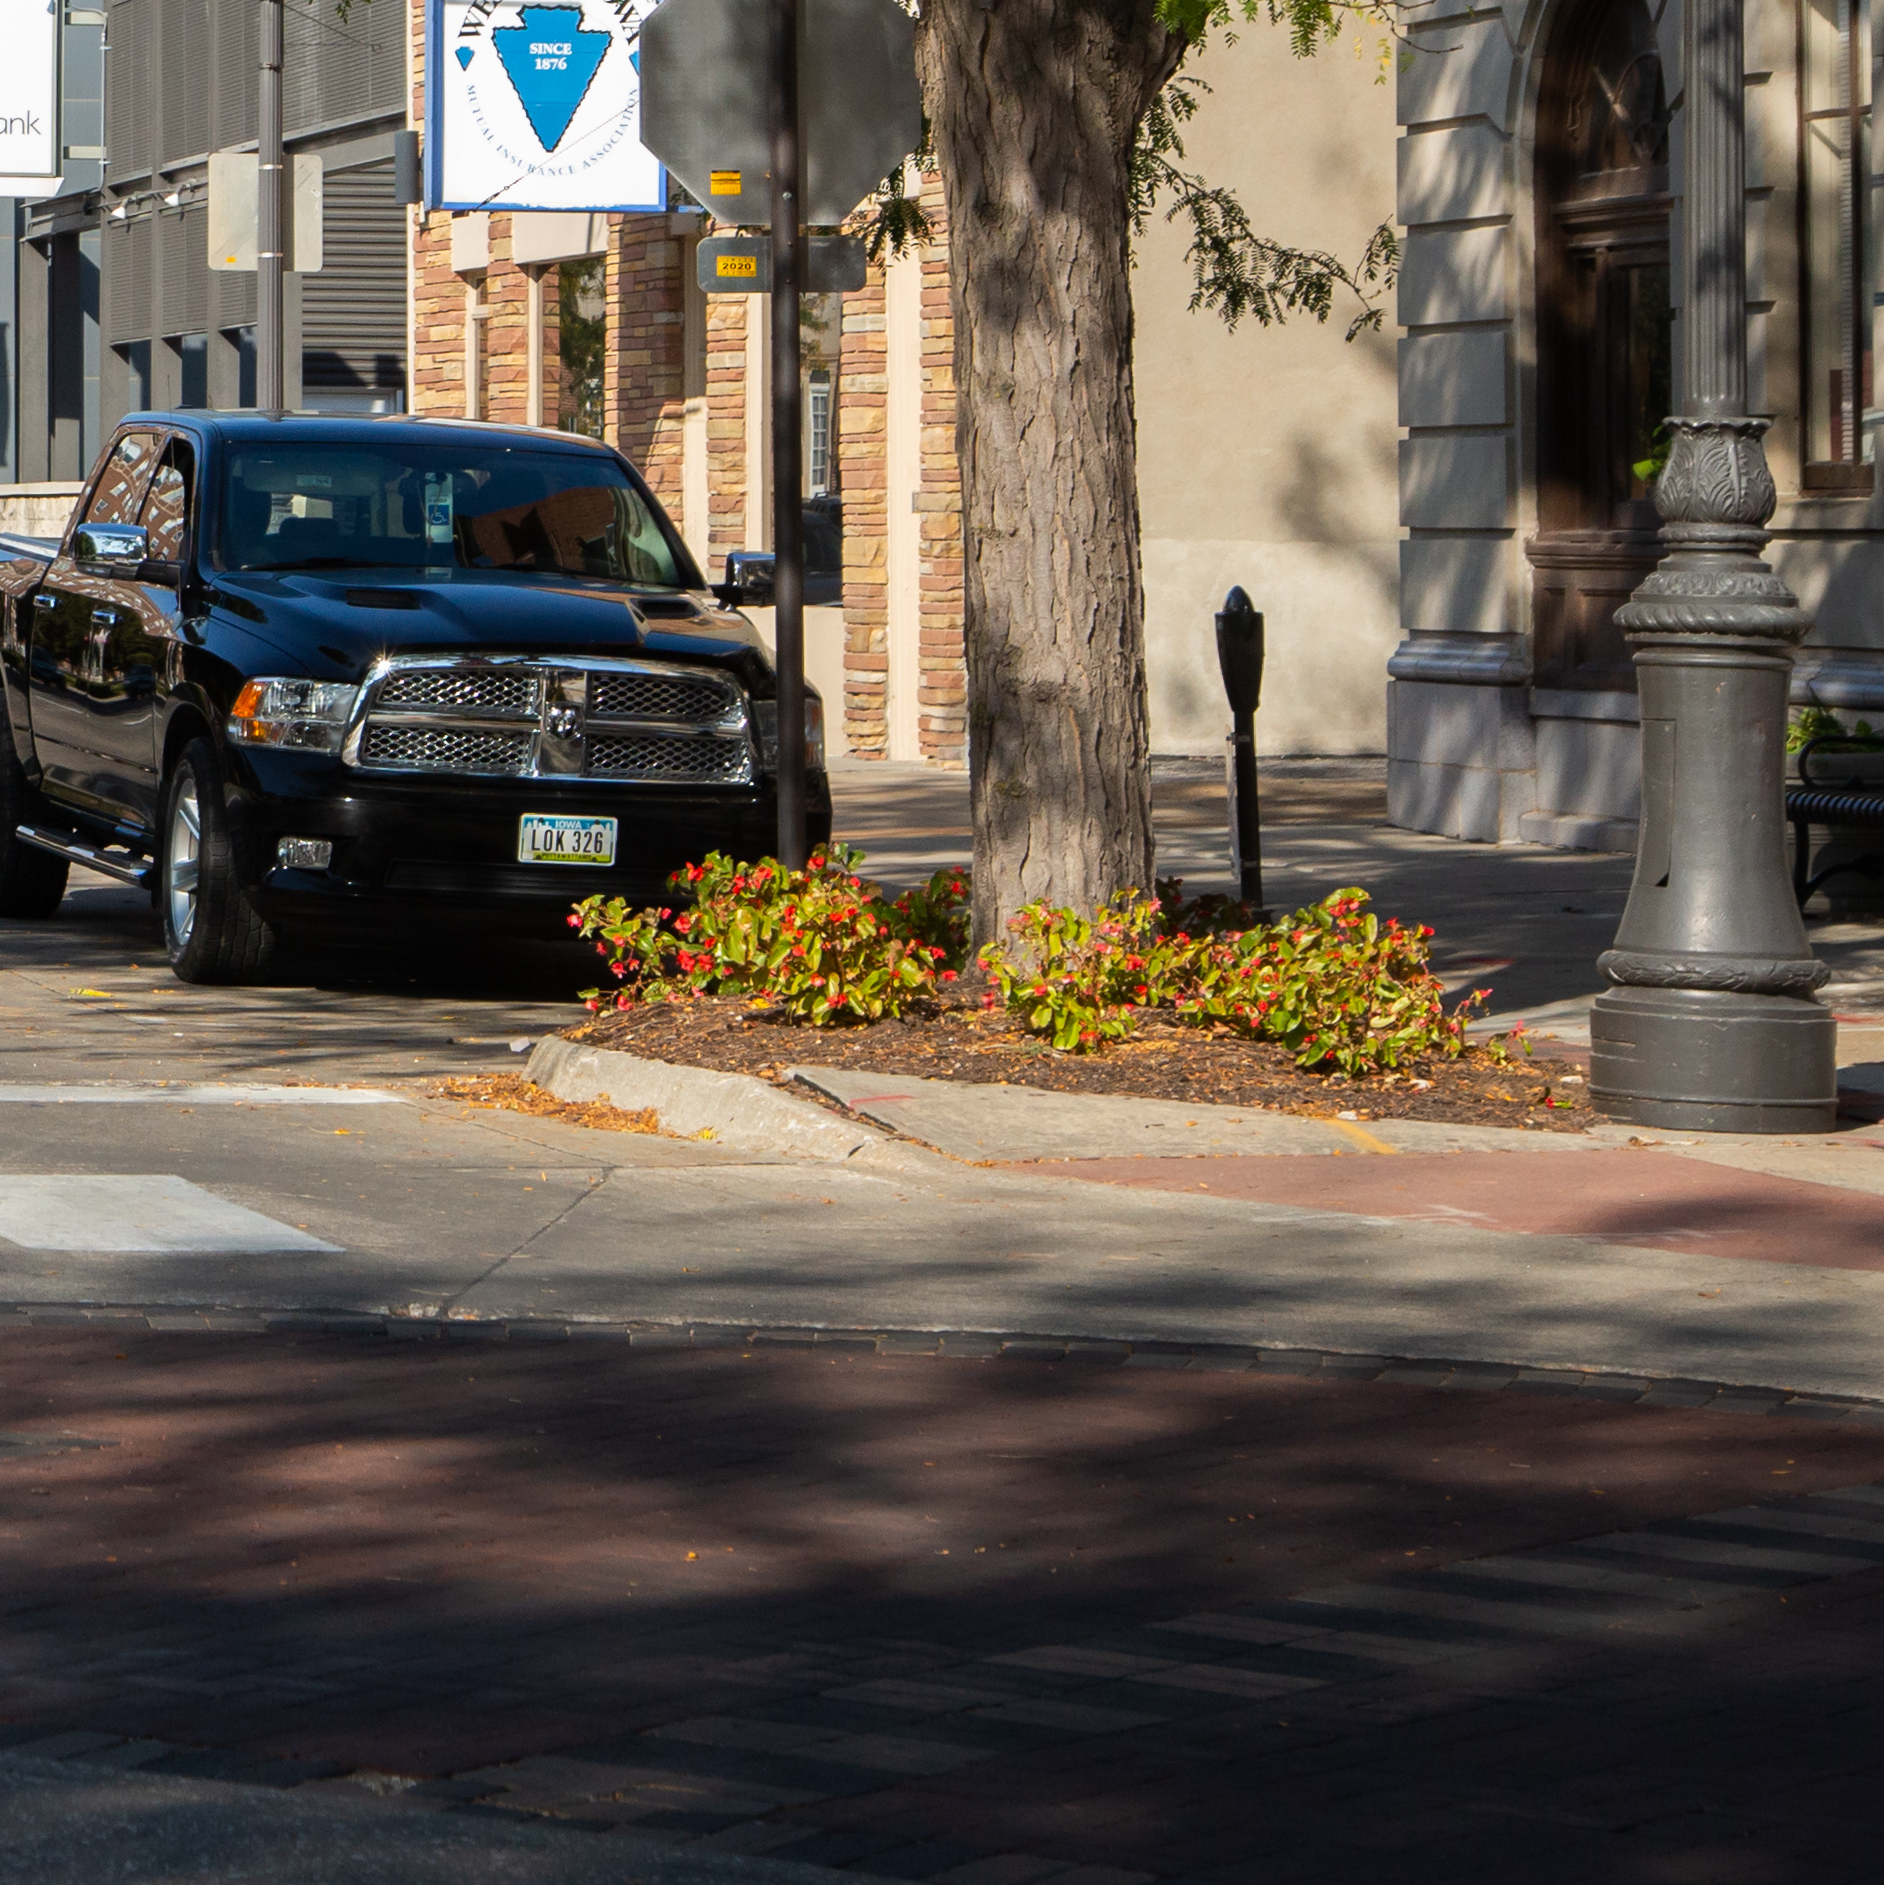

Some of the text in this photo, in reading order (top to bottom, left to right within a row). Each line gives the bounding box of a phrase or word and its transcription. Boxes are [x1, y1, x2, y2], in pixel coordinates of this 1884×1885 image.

[529, 42, 572, 56] SINCE
[534, 57, 567, 70] 1876
[466, 83, 639, 177] MUTUAL INSURANCE ASSOCIATION
[722, 262, 752, 270] 2020
[554, 819, 582, 829] IOWA
[572, 830, 604, 854] 326
